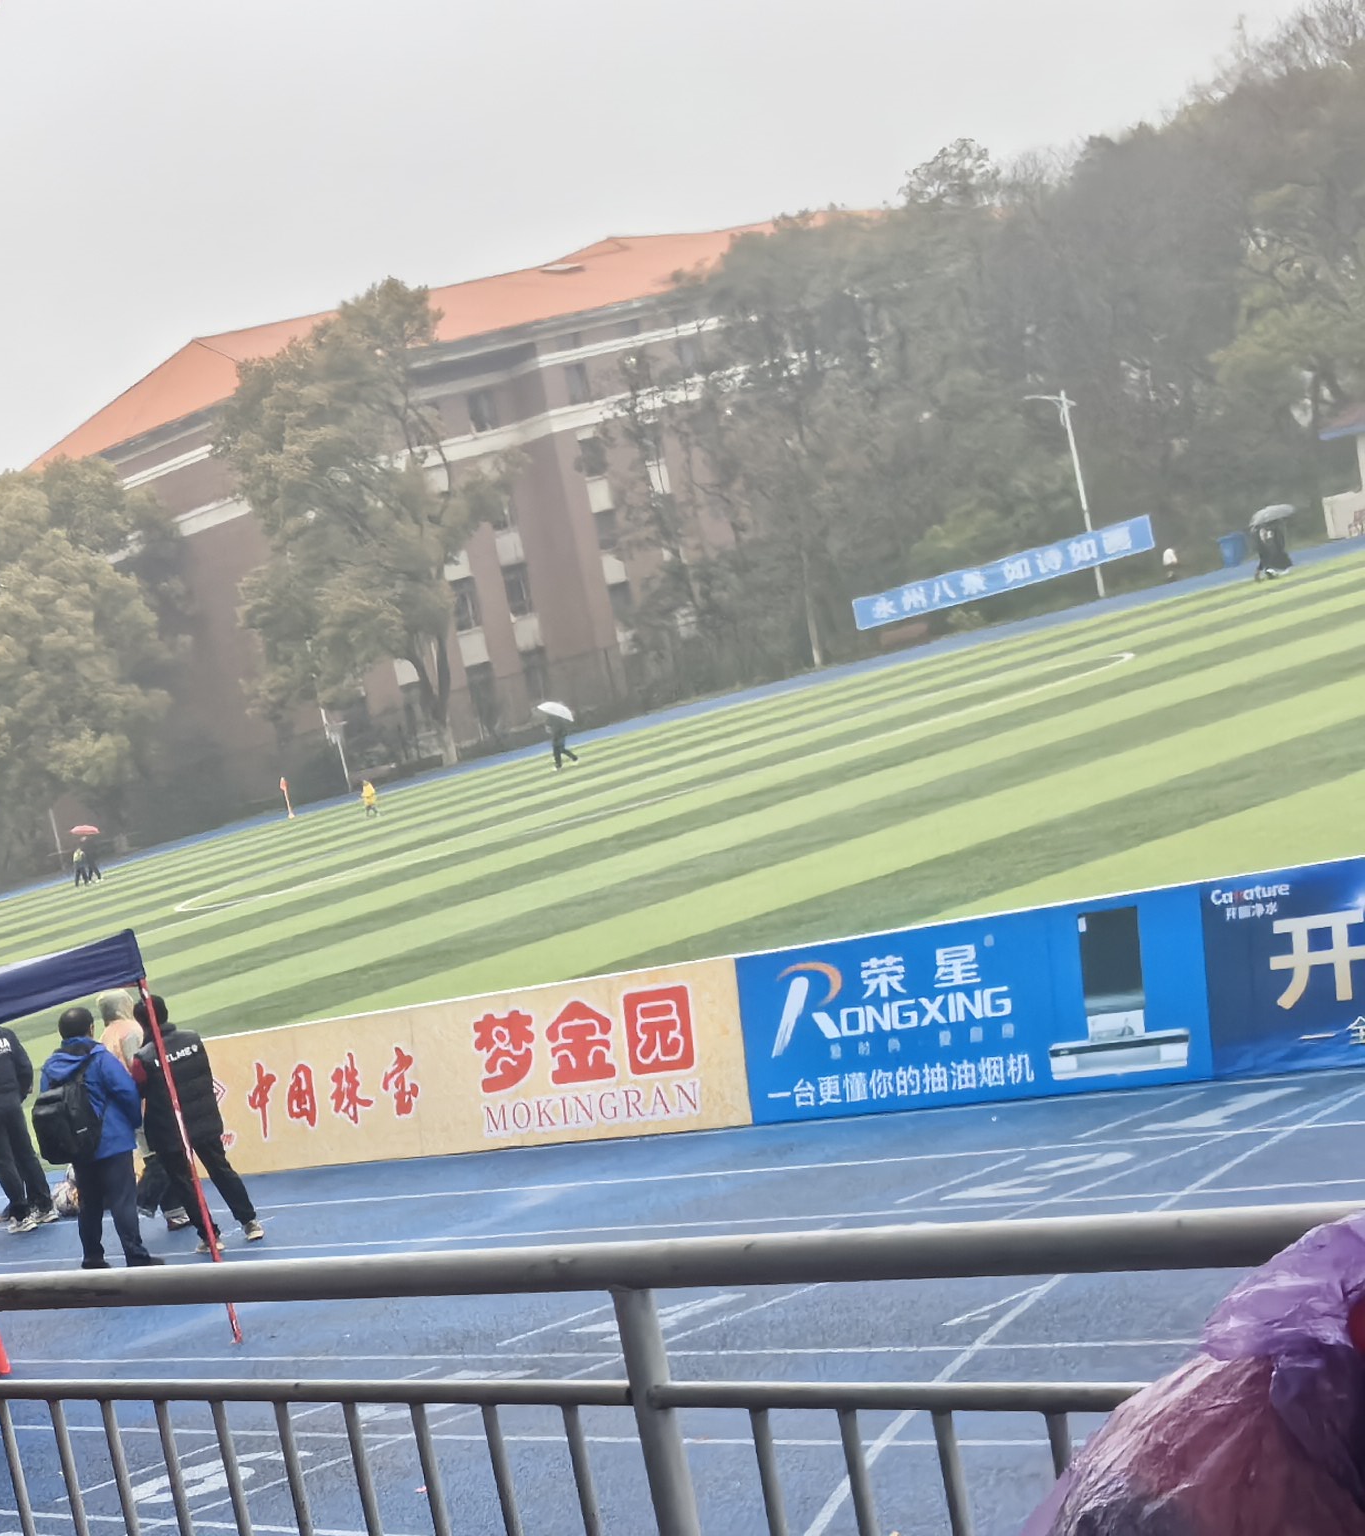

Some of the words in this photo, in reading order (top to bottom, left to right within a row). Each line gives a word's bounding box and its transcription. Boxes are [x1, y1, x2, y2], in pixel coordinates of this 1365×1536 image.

[860, 944, 981, 999] 荣星
[473, 985, 695, 1093] 梦金园
[247, 1045, 420, 1139] 中国珠宝
[485, 1081, 699, 1133] MOKINGRAN
[767, 1052, 1035, 1108] 一台更懂你的抽油烟机
